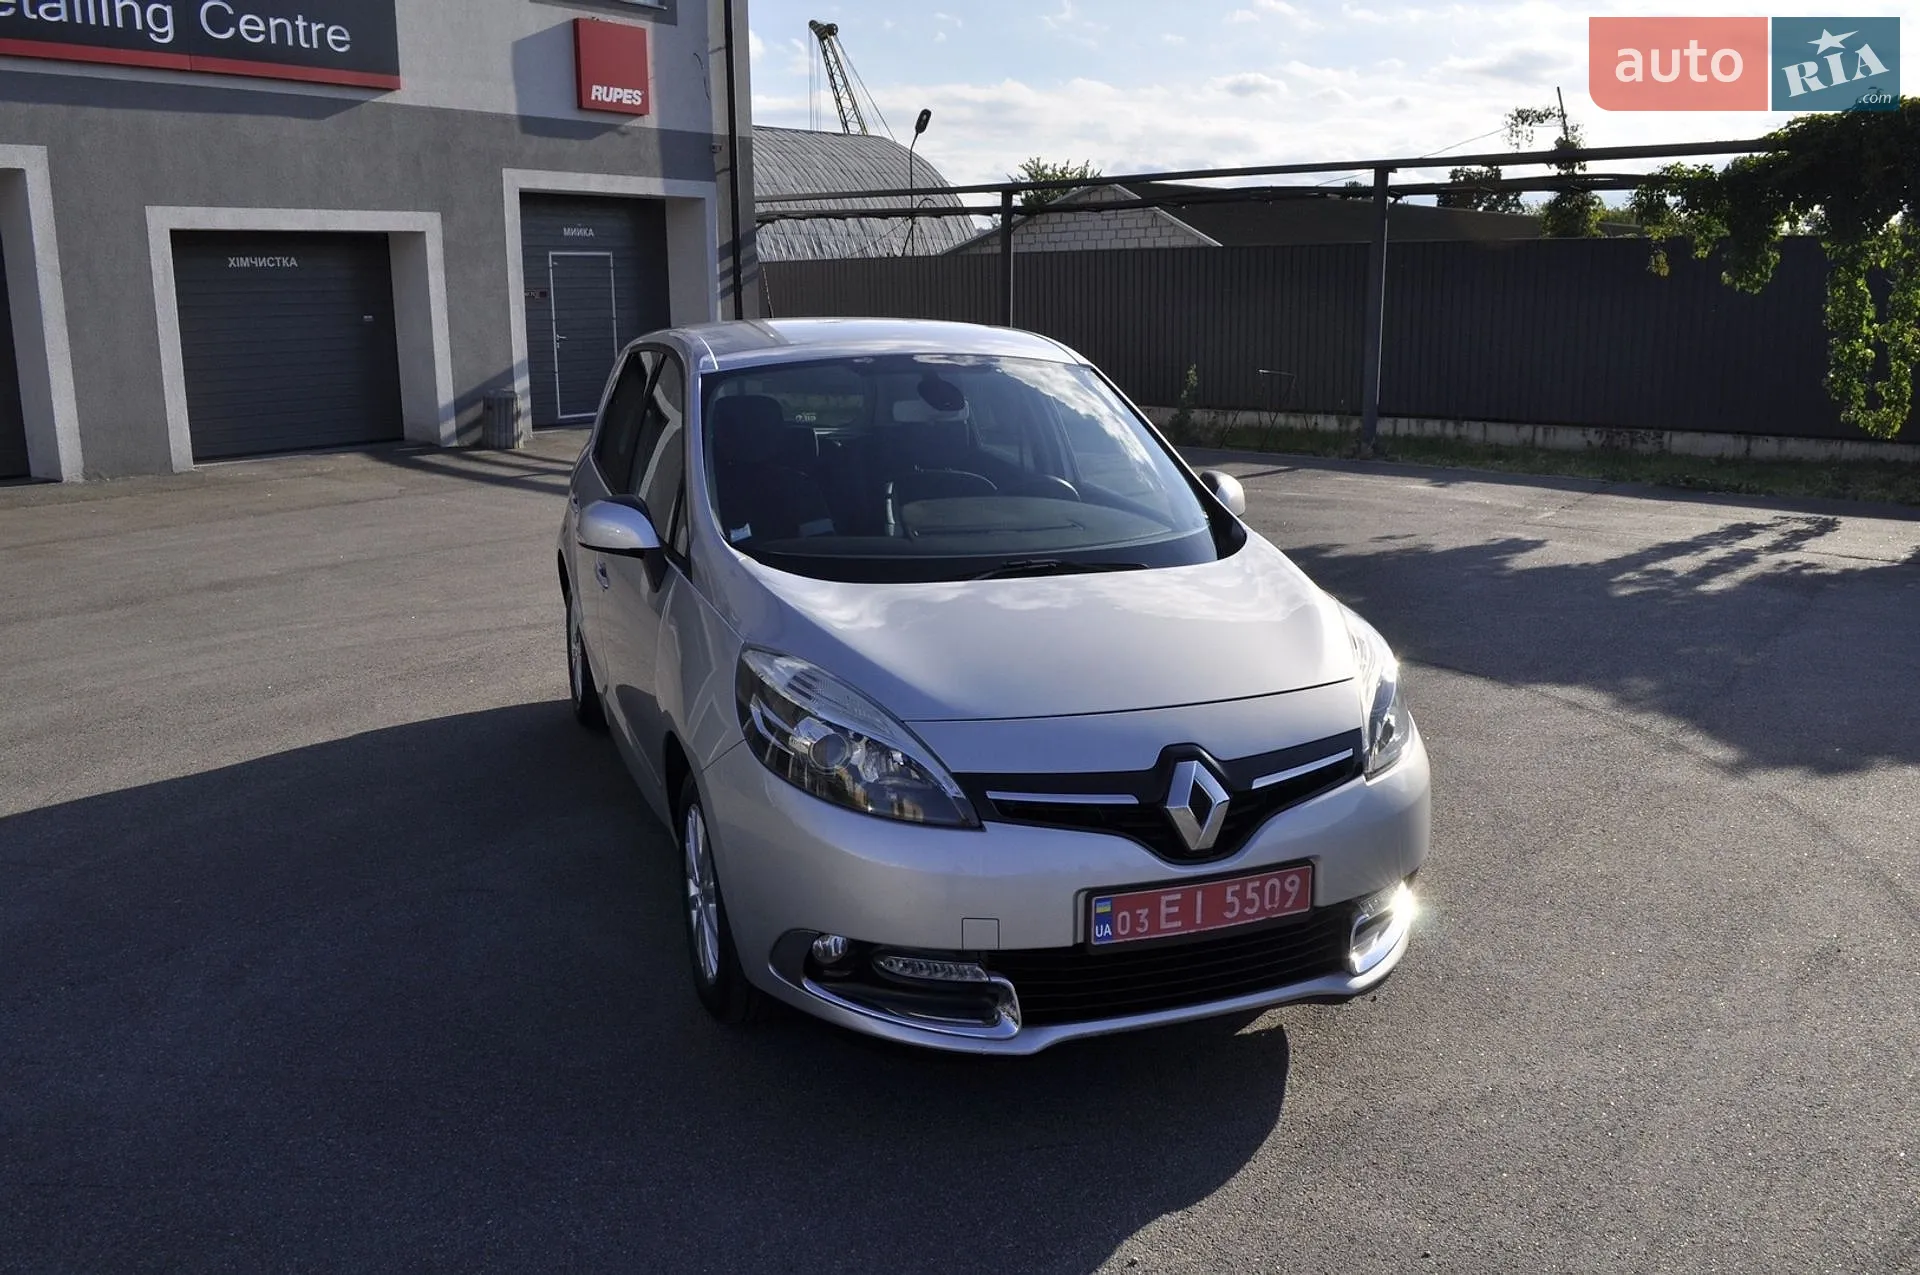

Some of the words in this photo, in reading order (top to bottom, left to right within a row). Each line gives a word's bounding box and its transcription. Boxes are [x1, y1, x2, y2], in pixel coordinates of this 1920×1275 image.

[200, 0, 350, 52] Centre
[591, 84, 642, 106] RUPES
[227, 256, 298, 268] ХІМЧИСТКА
[1117, 908, 1149, 935] 03
[1223, 874, 1301, 919] 5509
[1095, 923, 1112, 938] UA
